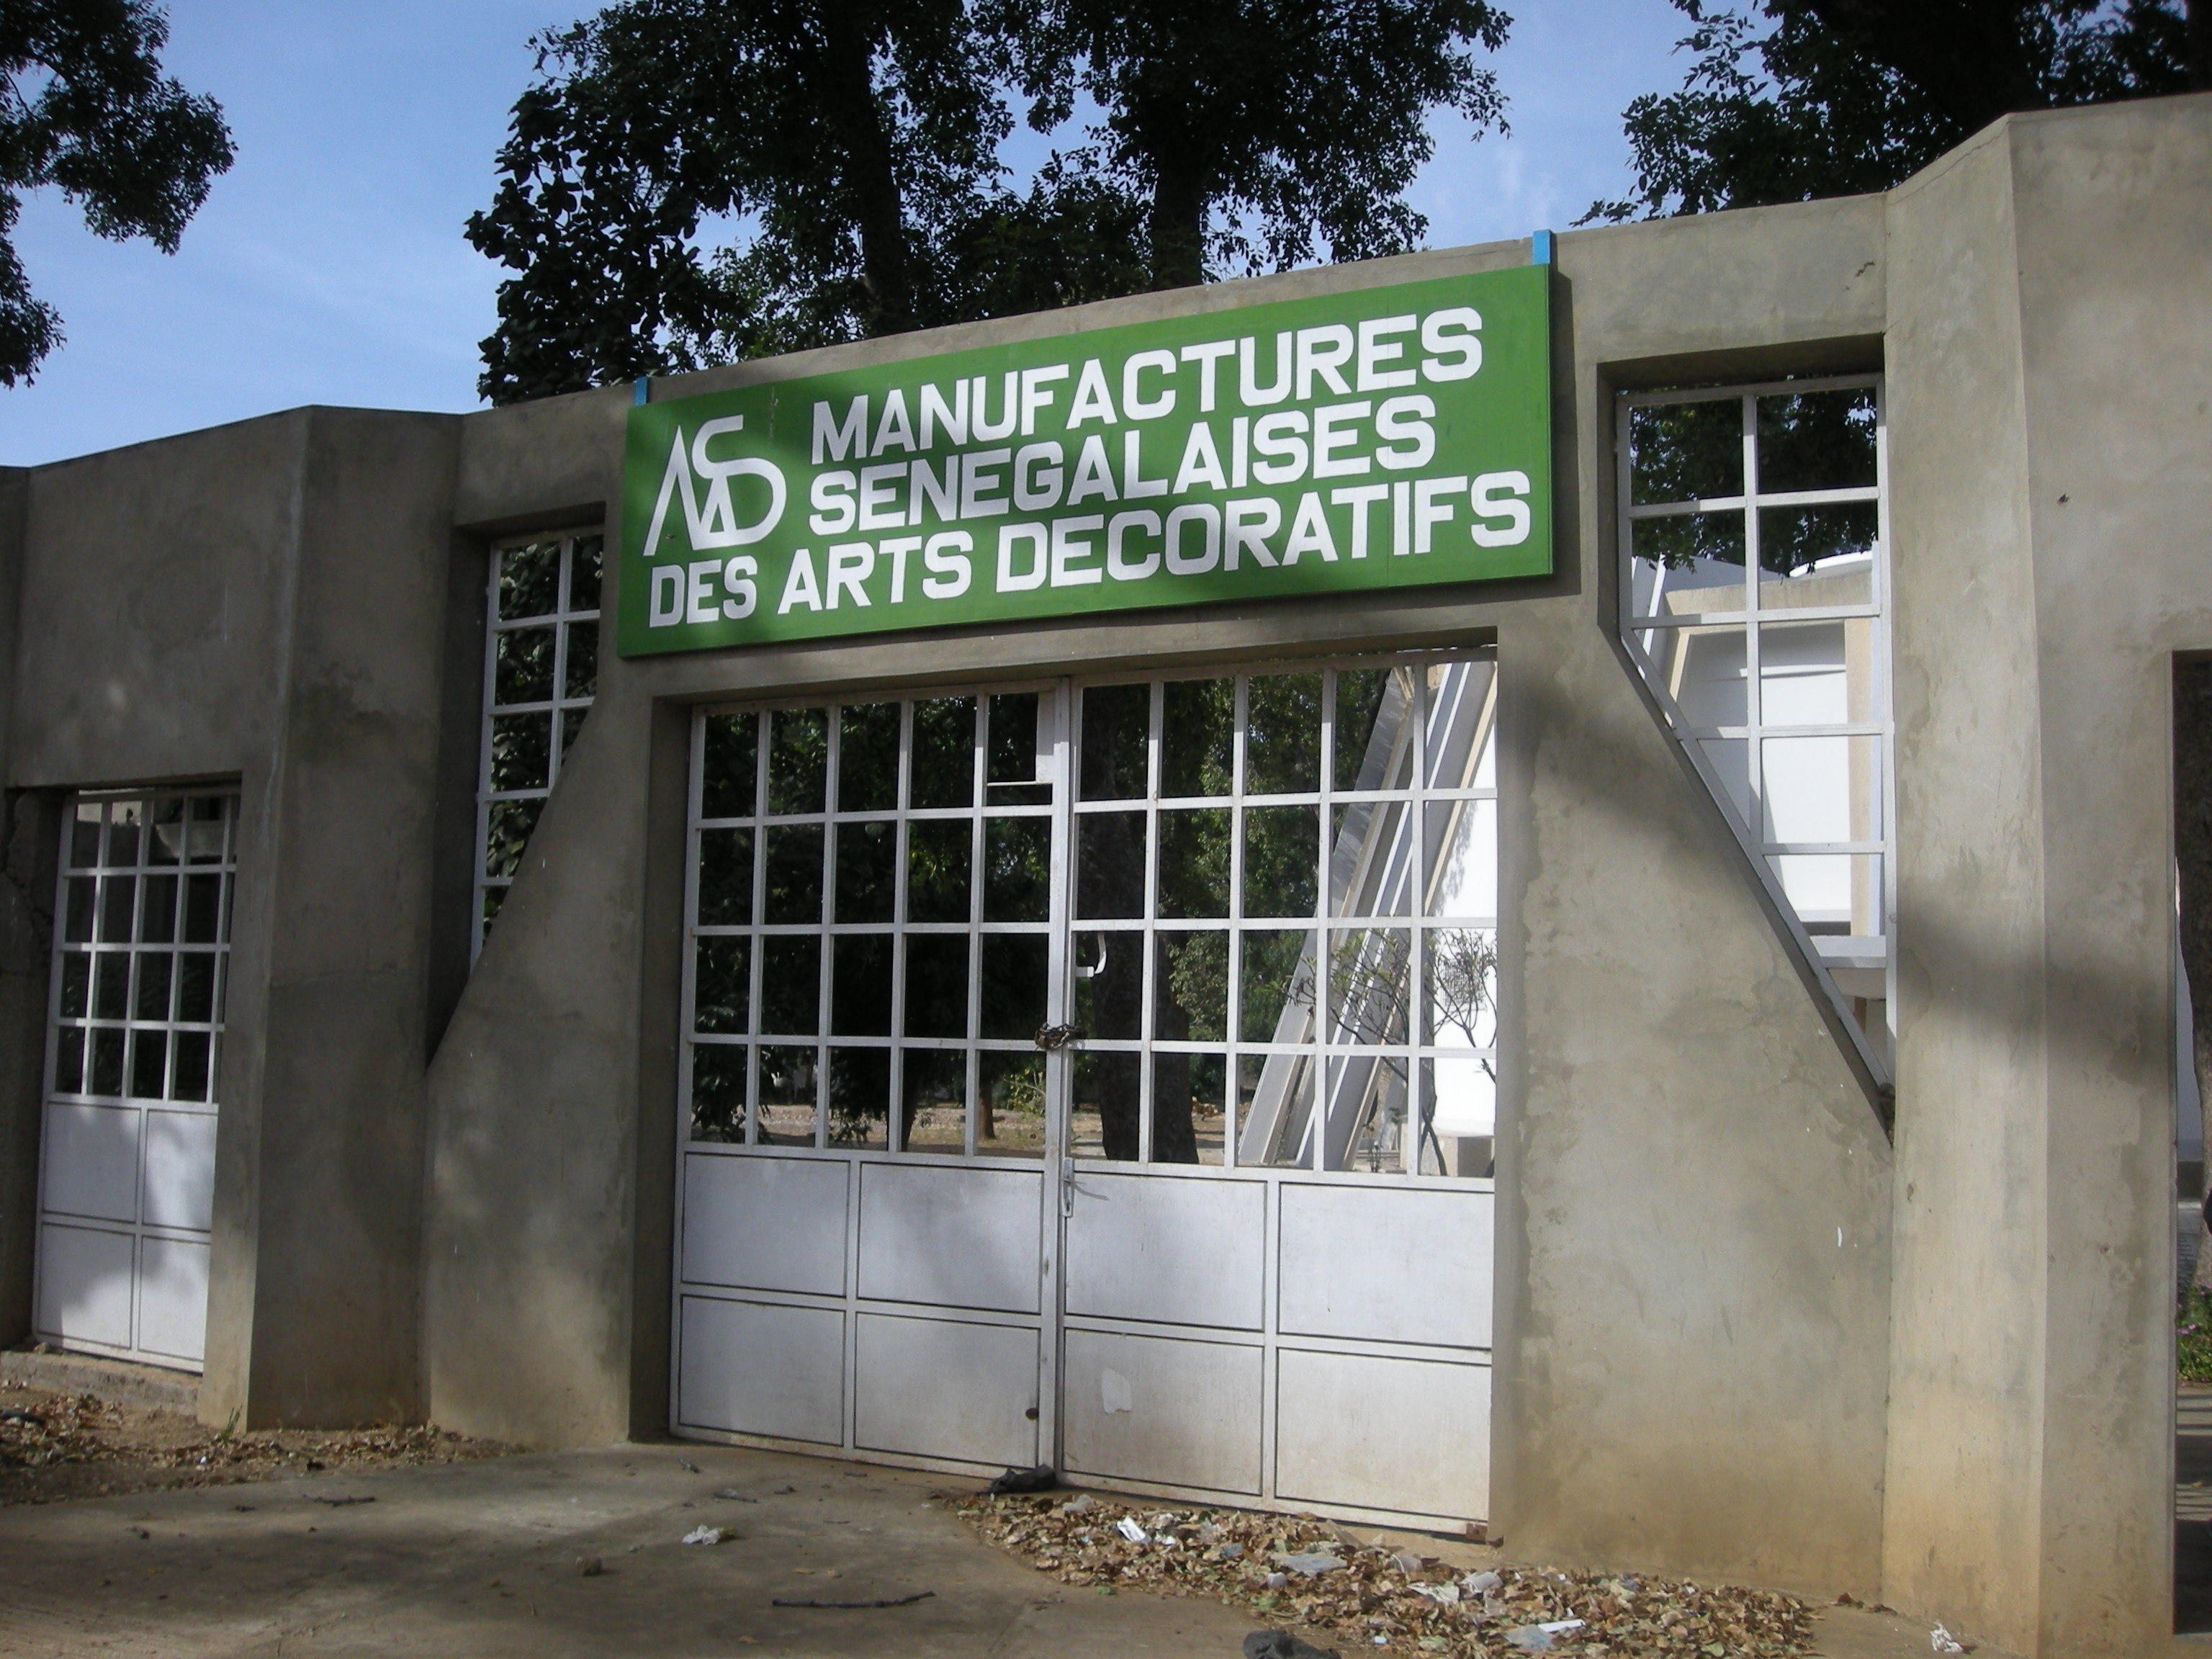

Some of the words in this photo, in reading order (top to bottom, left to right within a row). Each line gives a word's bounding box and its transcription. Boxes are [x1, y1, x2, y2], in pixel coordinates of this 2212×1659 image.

[809, 394, 1437, 536] SENEGALAISES
[811, 307, 1483, 465] MANUFACTURES
[649, 555, 758, 628] DES
[777, 530, 974, 614] ARTS
[995, 469, 1532, 593] DECORATIFS
